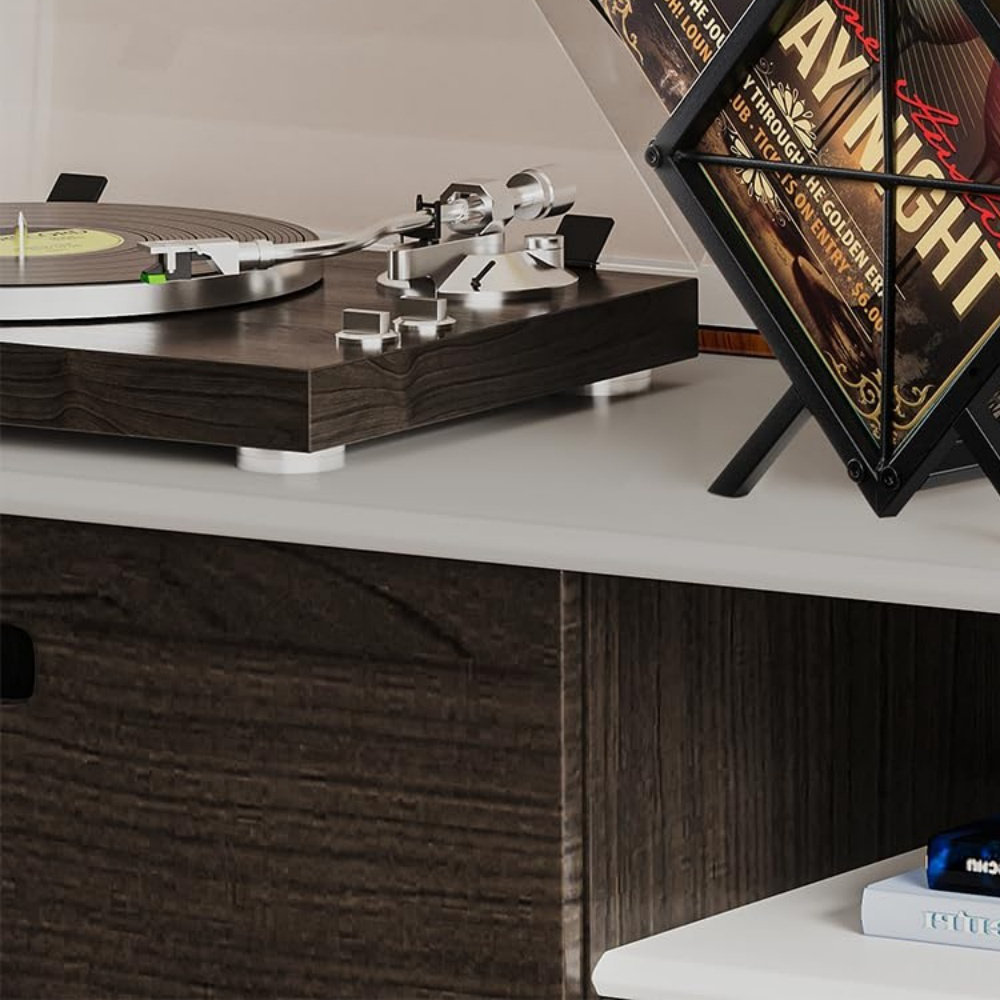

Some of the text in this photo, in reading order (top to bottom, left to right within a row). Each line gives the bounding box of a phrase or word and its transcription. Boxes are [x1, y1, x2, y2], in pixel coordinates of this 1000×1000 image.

[750, 86, 805, 165] THROUGH
[800, 173, 826, 202] HE
[822, 200, 872, 269] GOLDEN
[864, 261, 884, 299] ER
[793, 193, 815, 222] ON
[810, 217, 851, 275] ENTRY
